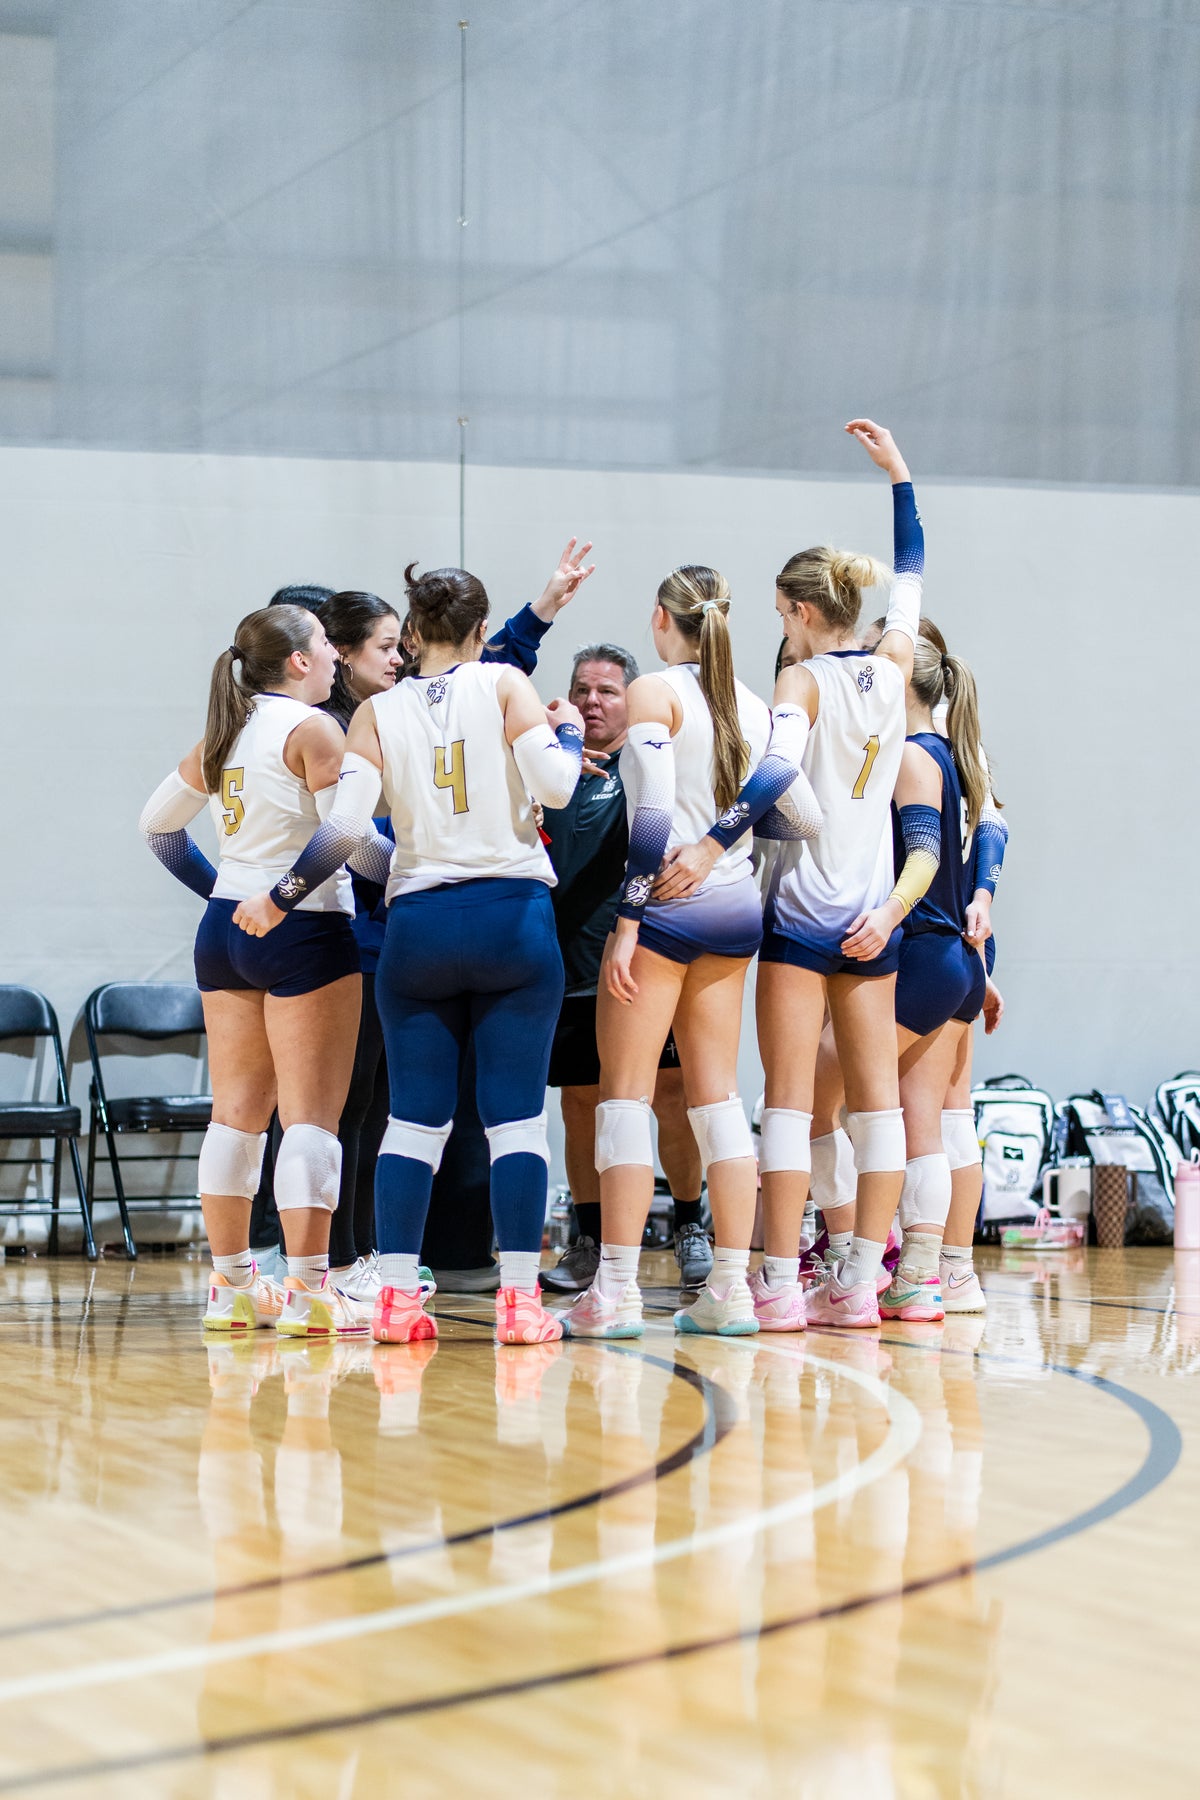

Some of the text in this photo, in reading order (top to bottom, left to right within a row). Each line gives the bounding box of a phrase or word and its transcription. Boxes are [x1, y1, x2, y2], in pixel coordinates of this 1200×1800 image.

[221, 766, 246, 836] 5
[433, 738, 470, 815] 4
[850, 734, 881, 800] 1
